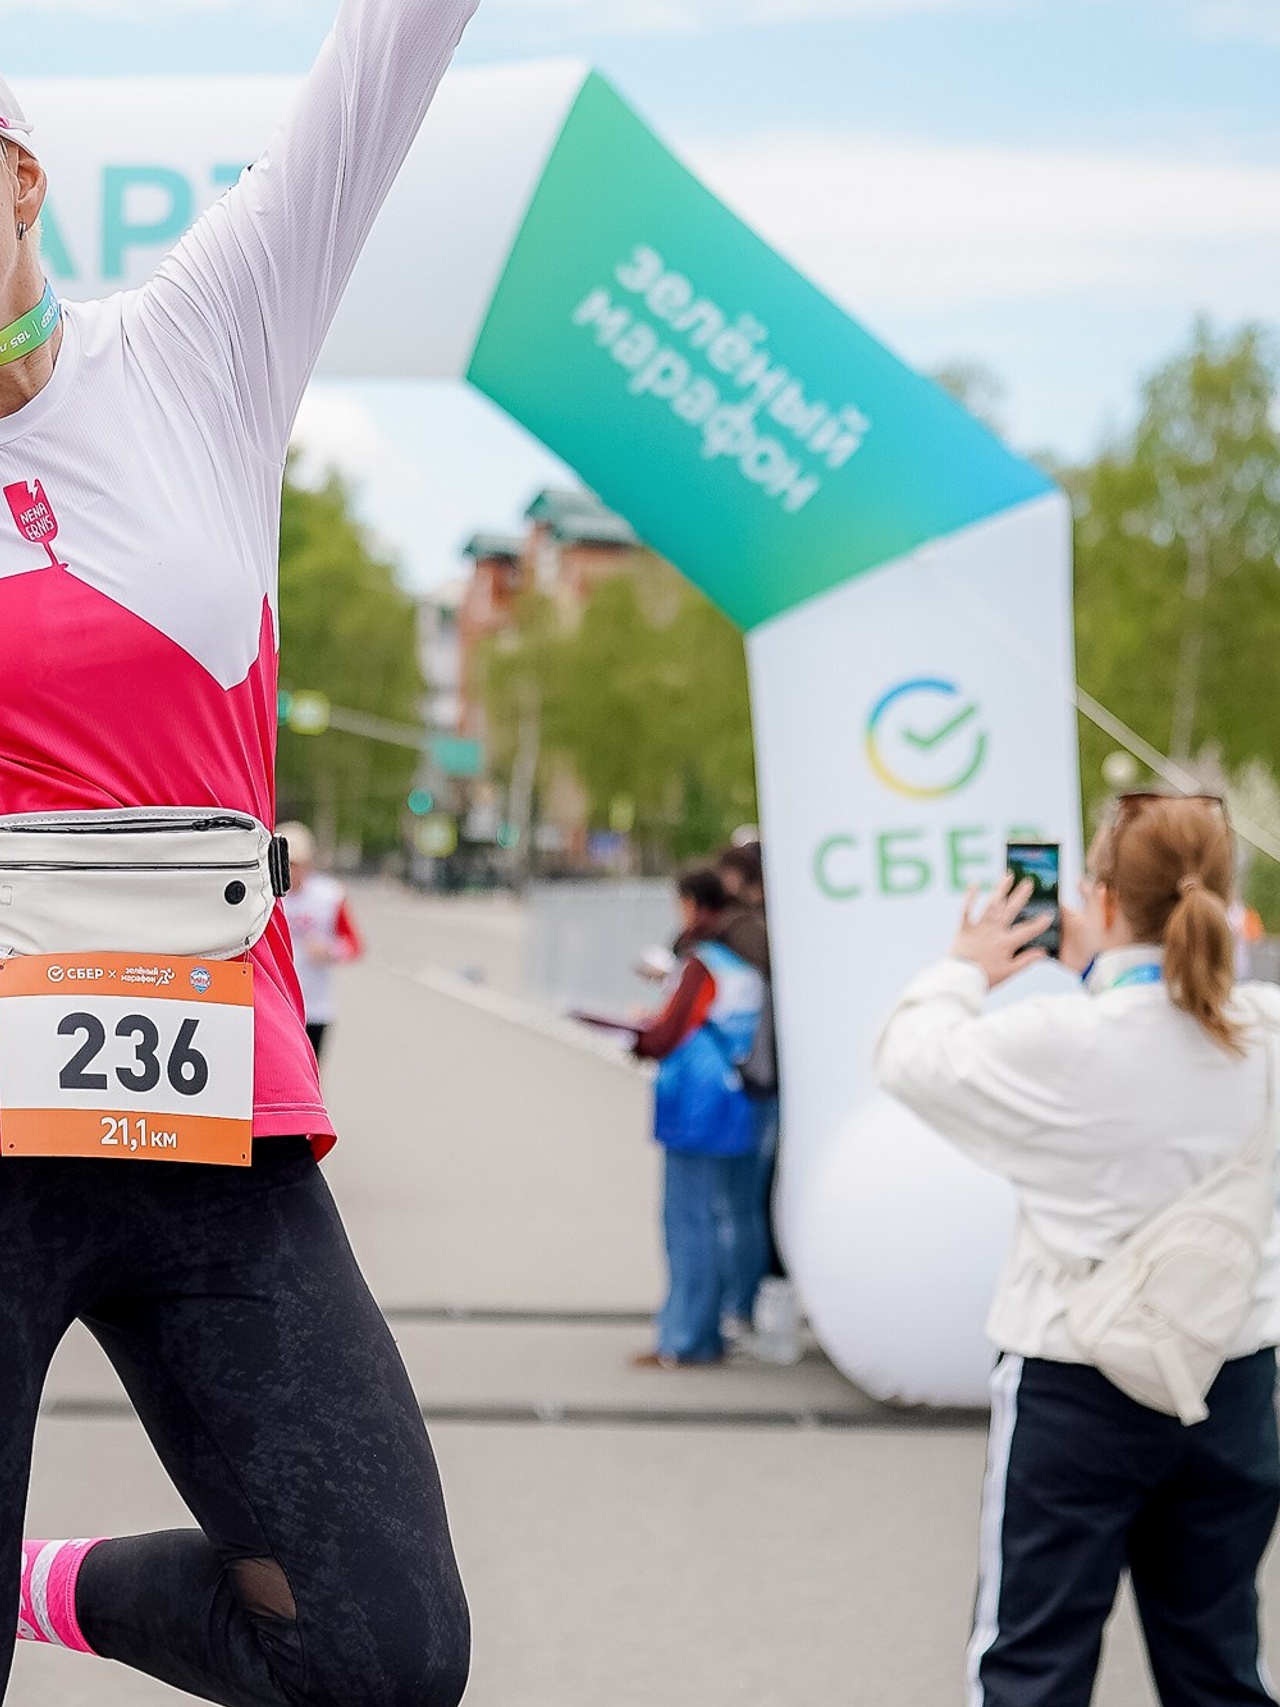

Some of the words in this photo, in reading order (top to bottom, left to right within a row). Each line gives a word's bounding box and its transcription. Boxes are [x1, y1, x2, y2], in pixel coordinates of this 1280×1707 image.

[9, 329, 32, 349] 185
[616, 244, 871, 469] зелёный
[572, 287, 820, 513] марафон
[813, 822, 1045, 900] СБЕ
[66, 967, 104, 980] СБЕР
[120, 974, 156, 985] марафон
[57, 1012, 209, 1096] 236
